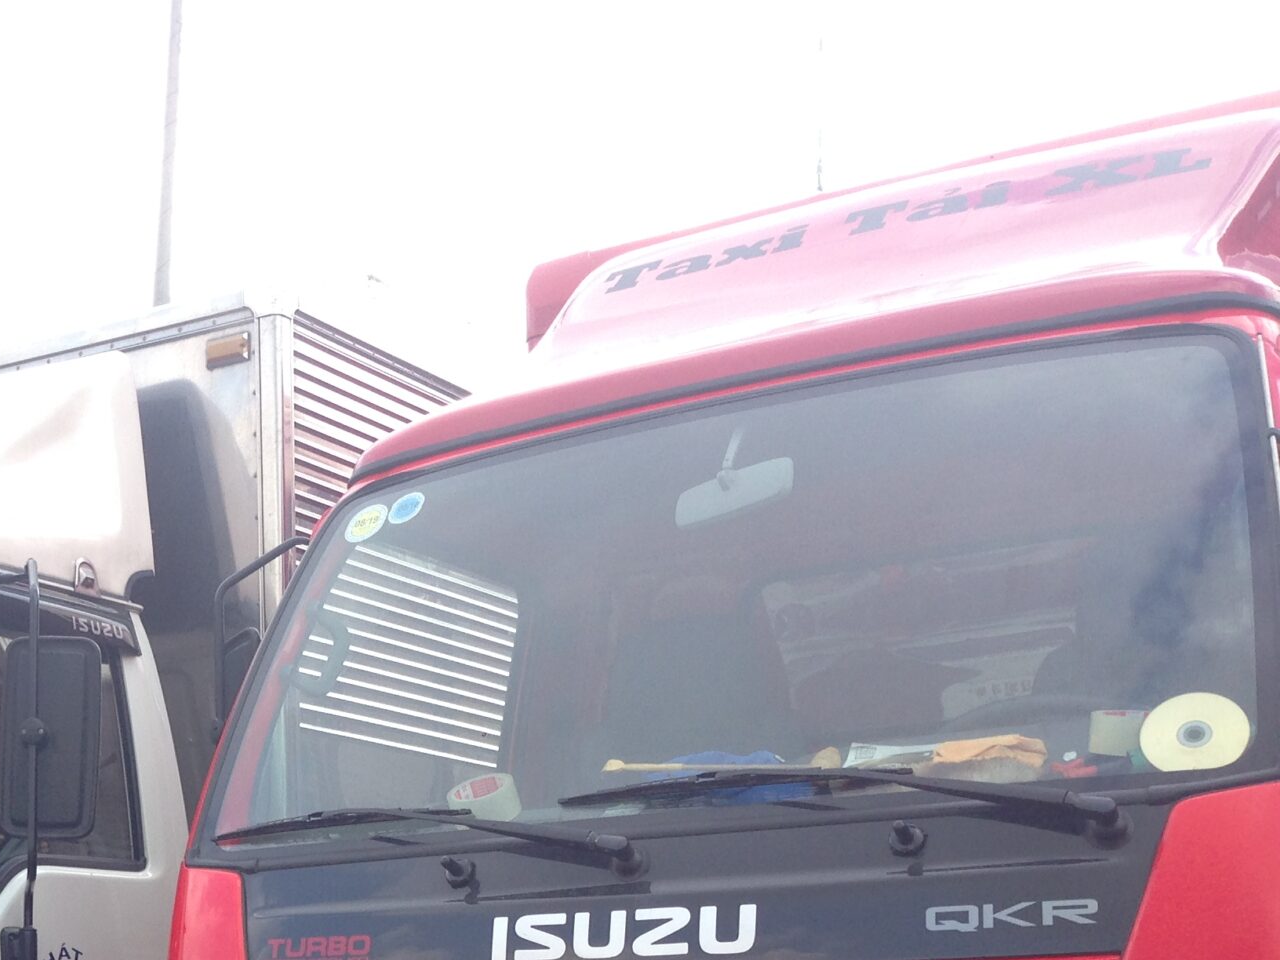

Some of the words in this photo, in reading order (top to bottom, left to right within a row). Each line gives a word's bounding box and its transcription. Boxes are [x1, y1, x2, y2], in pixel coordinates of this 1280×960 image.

[605, 223, 808, 294] Taxi
[1042, 147, 1213, 197] XL
[72, 615, 123, 639] ISUZU
[924, 898, 1099, 933] QKR
[267, 935, 371, 959] TURBO
